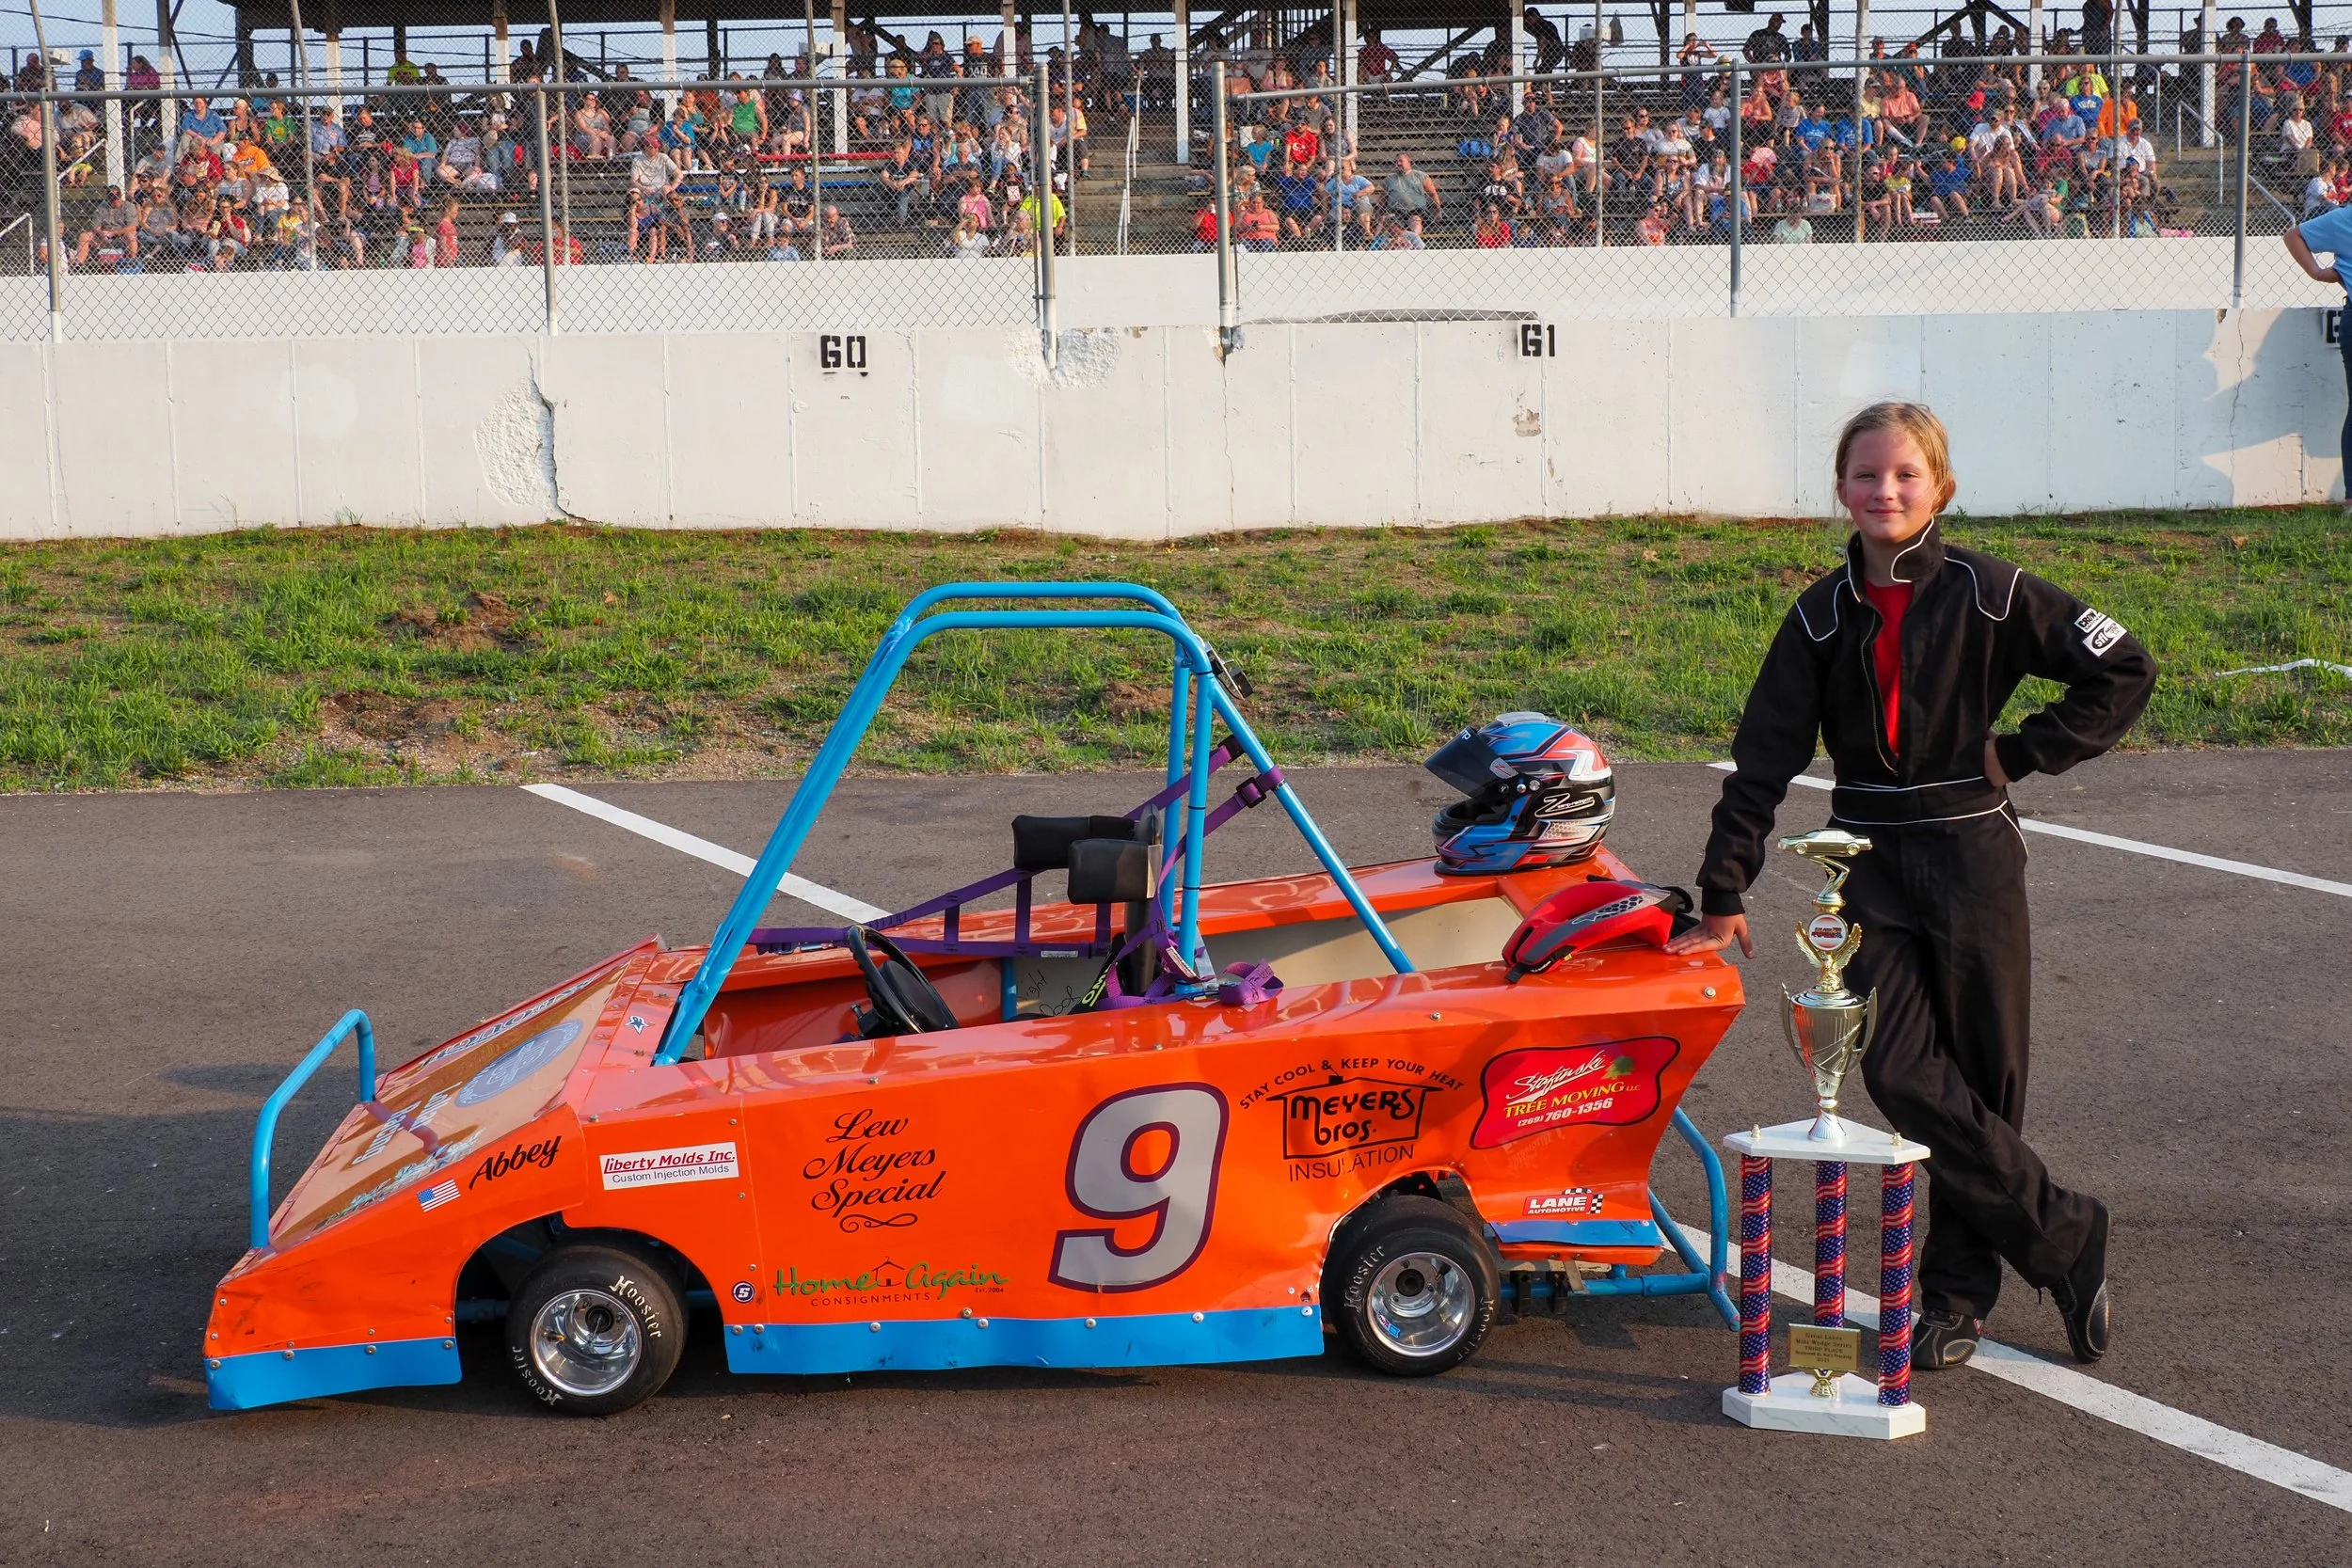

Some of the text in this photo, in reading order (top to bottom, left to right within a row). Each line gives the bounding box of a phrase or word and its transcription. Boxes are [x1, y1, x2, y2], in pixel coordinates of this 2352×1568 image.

[820, 335, 866, 368] 60
[1521, 325, 1555, 356] 61
[2077, 610, 2097, 628] CROW
[1239, 1058, 1465, 1109] STAY COOL & KEEP YOUR HEAT
[1504, 1100, 1547, 1118] TREE
[1551, 1082, 1625, 1108] MOVING
[825, 1108, 909, 1143] Lew
[1518, 1097, 1613, 1127] (269) 760-1356
[469, 1136, 562, 1190] Abbey
[603, 1149, 736, 1175] Liberty Molds Inc.
[612, 1164, 729, 1184] Custom Injection Molds
[803, 1142, 936, 1181] Meyers
[811, 1171, 946, 1218] Special
[1048, 1082, 1230, 1293] 9
[1530, 1196, 1587, 1209] LANE
[773, 1266, 881, 1295] Home
[609, 1275, 662, 1338] Hoosier
[811, 1292, 930, 1307] CONSIGNMENTS
[512, 1346, 564, 1406] Hoosier
